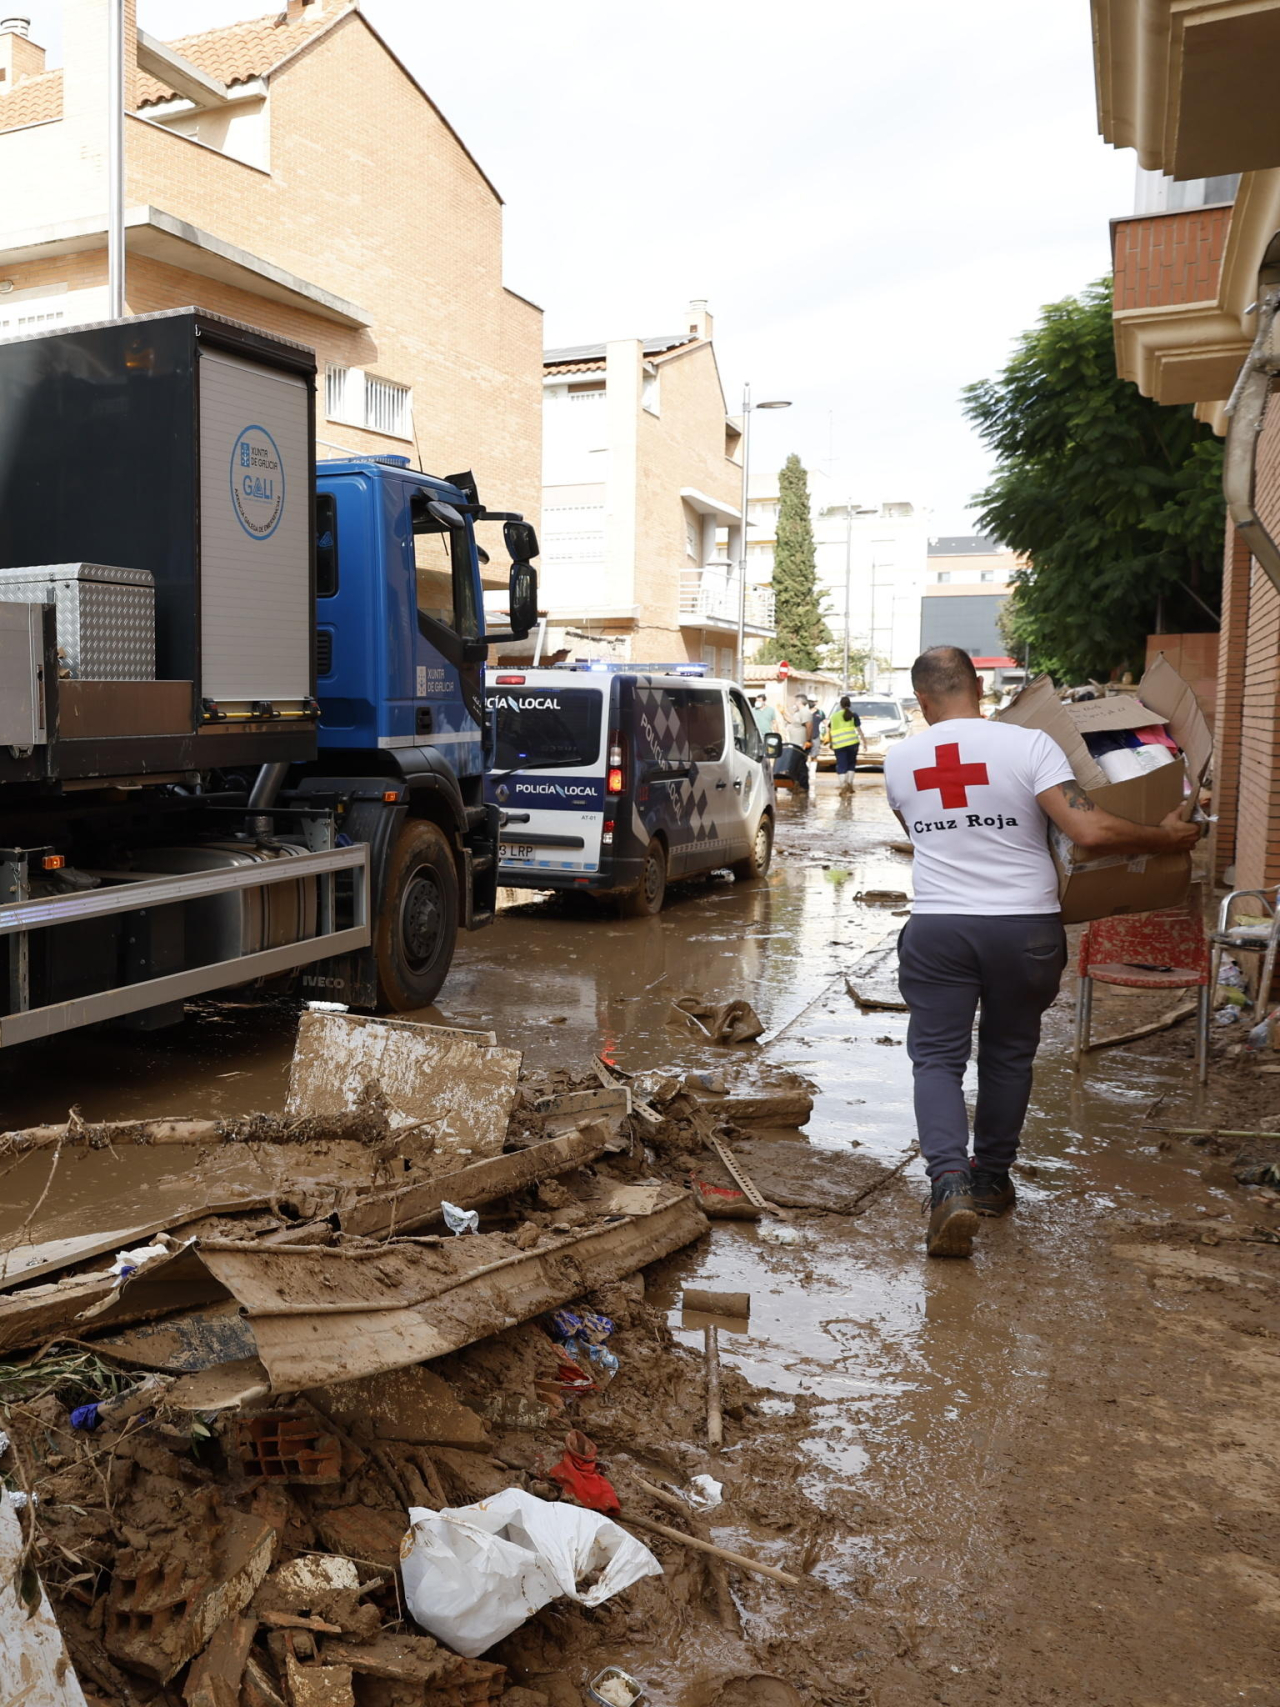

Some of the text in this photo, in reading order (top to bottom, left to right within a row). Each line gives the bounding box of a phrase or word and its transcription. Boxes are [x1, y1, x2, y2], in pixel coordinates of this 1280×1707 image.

[250, 446, 268, 458] XUNTA
[250, 457, 278, 470] DE GALICIA
[427, 668, 445, 679] XUNTA
[427, 681, 454, 692] DE GALICIA
[519, 698, 561, 709] LOCAL
[516, 783, 598, 796] POLICÍA LOCAL
[914, 814, 1019, 833] Cruz Roja
[510, 845, 533, 857] LRP
[302, 975, 345, 989] IVECO
